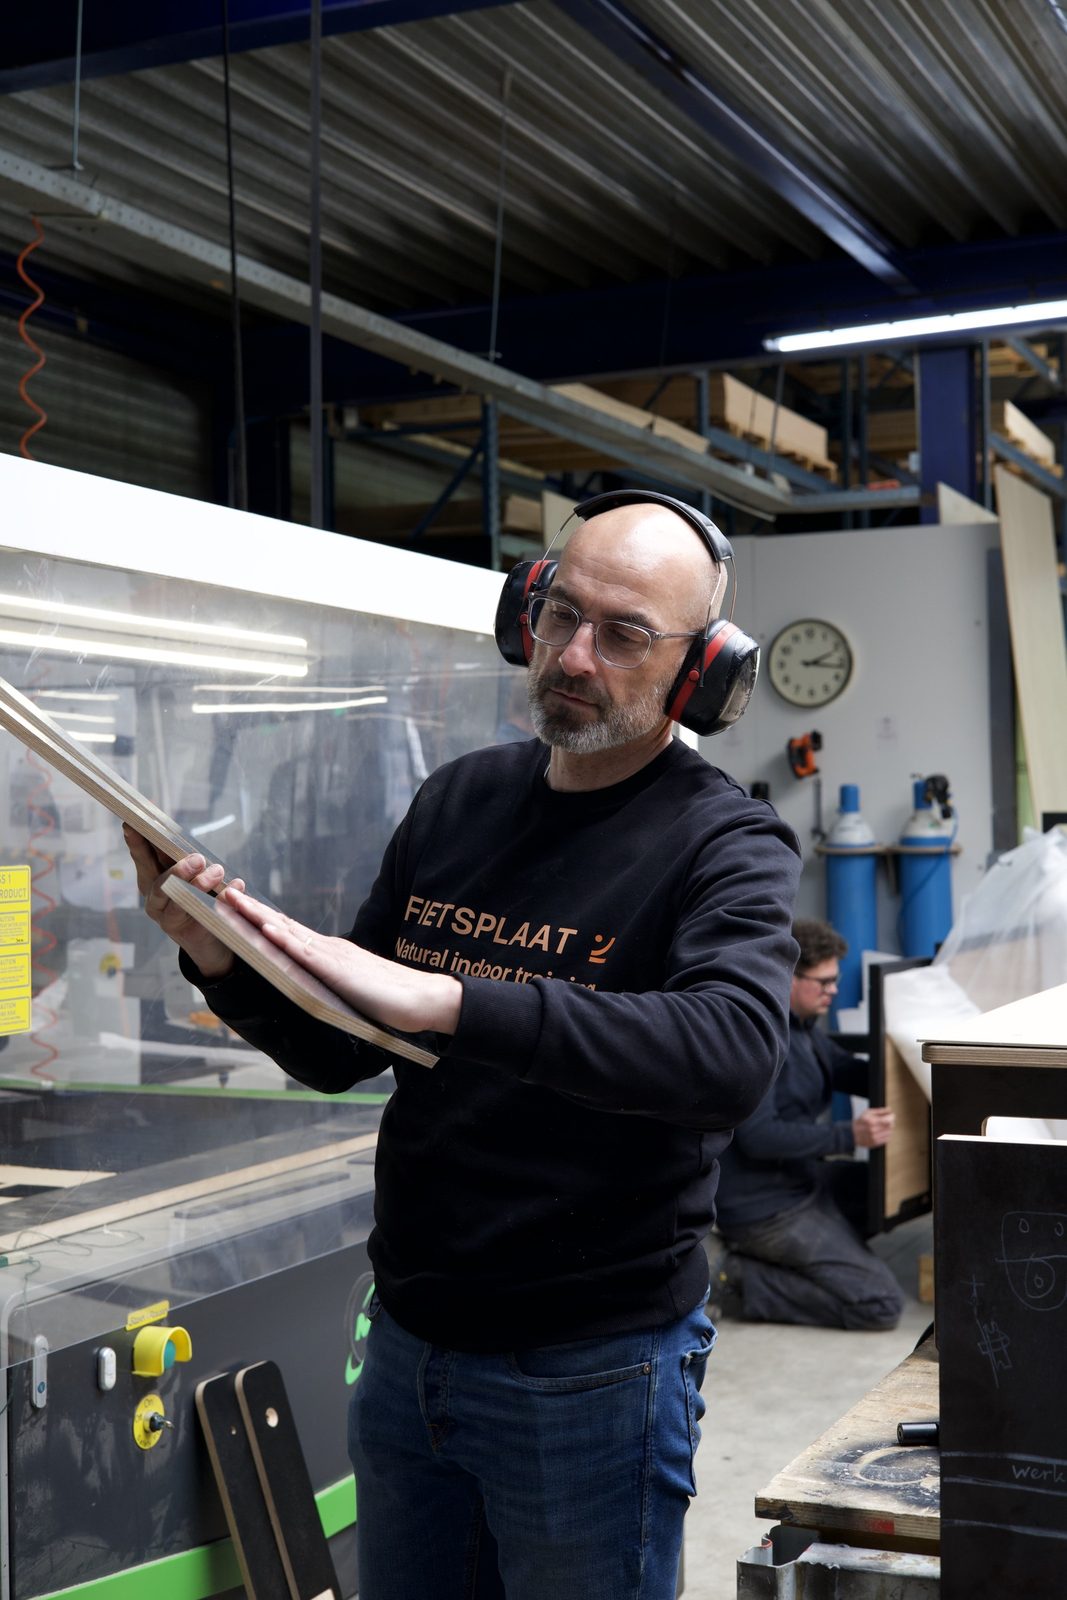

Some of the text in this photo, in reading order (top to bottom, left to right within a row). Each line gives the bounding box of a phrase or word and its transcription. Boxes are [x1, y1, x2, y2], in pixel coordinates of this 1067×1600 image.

[404, 895, 577, 954] FIETSPLAAT
[396, 937, 449, 968] Natural
[450, 952, 512, 981] indoor
